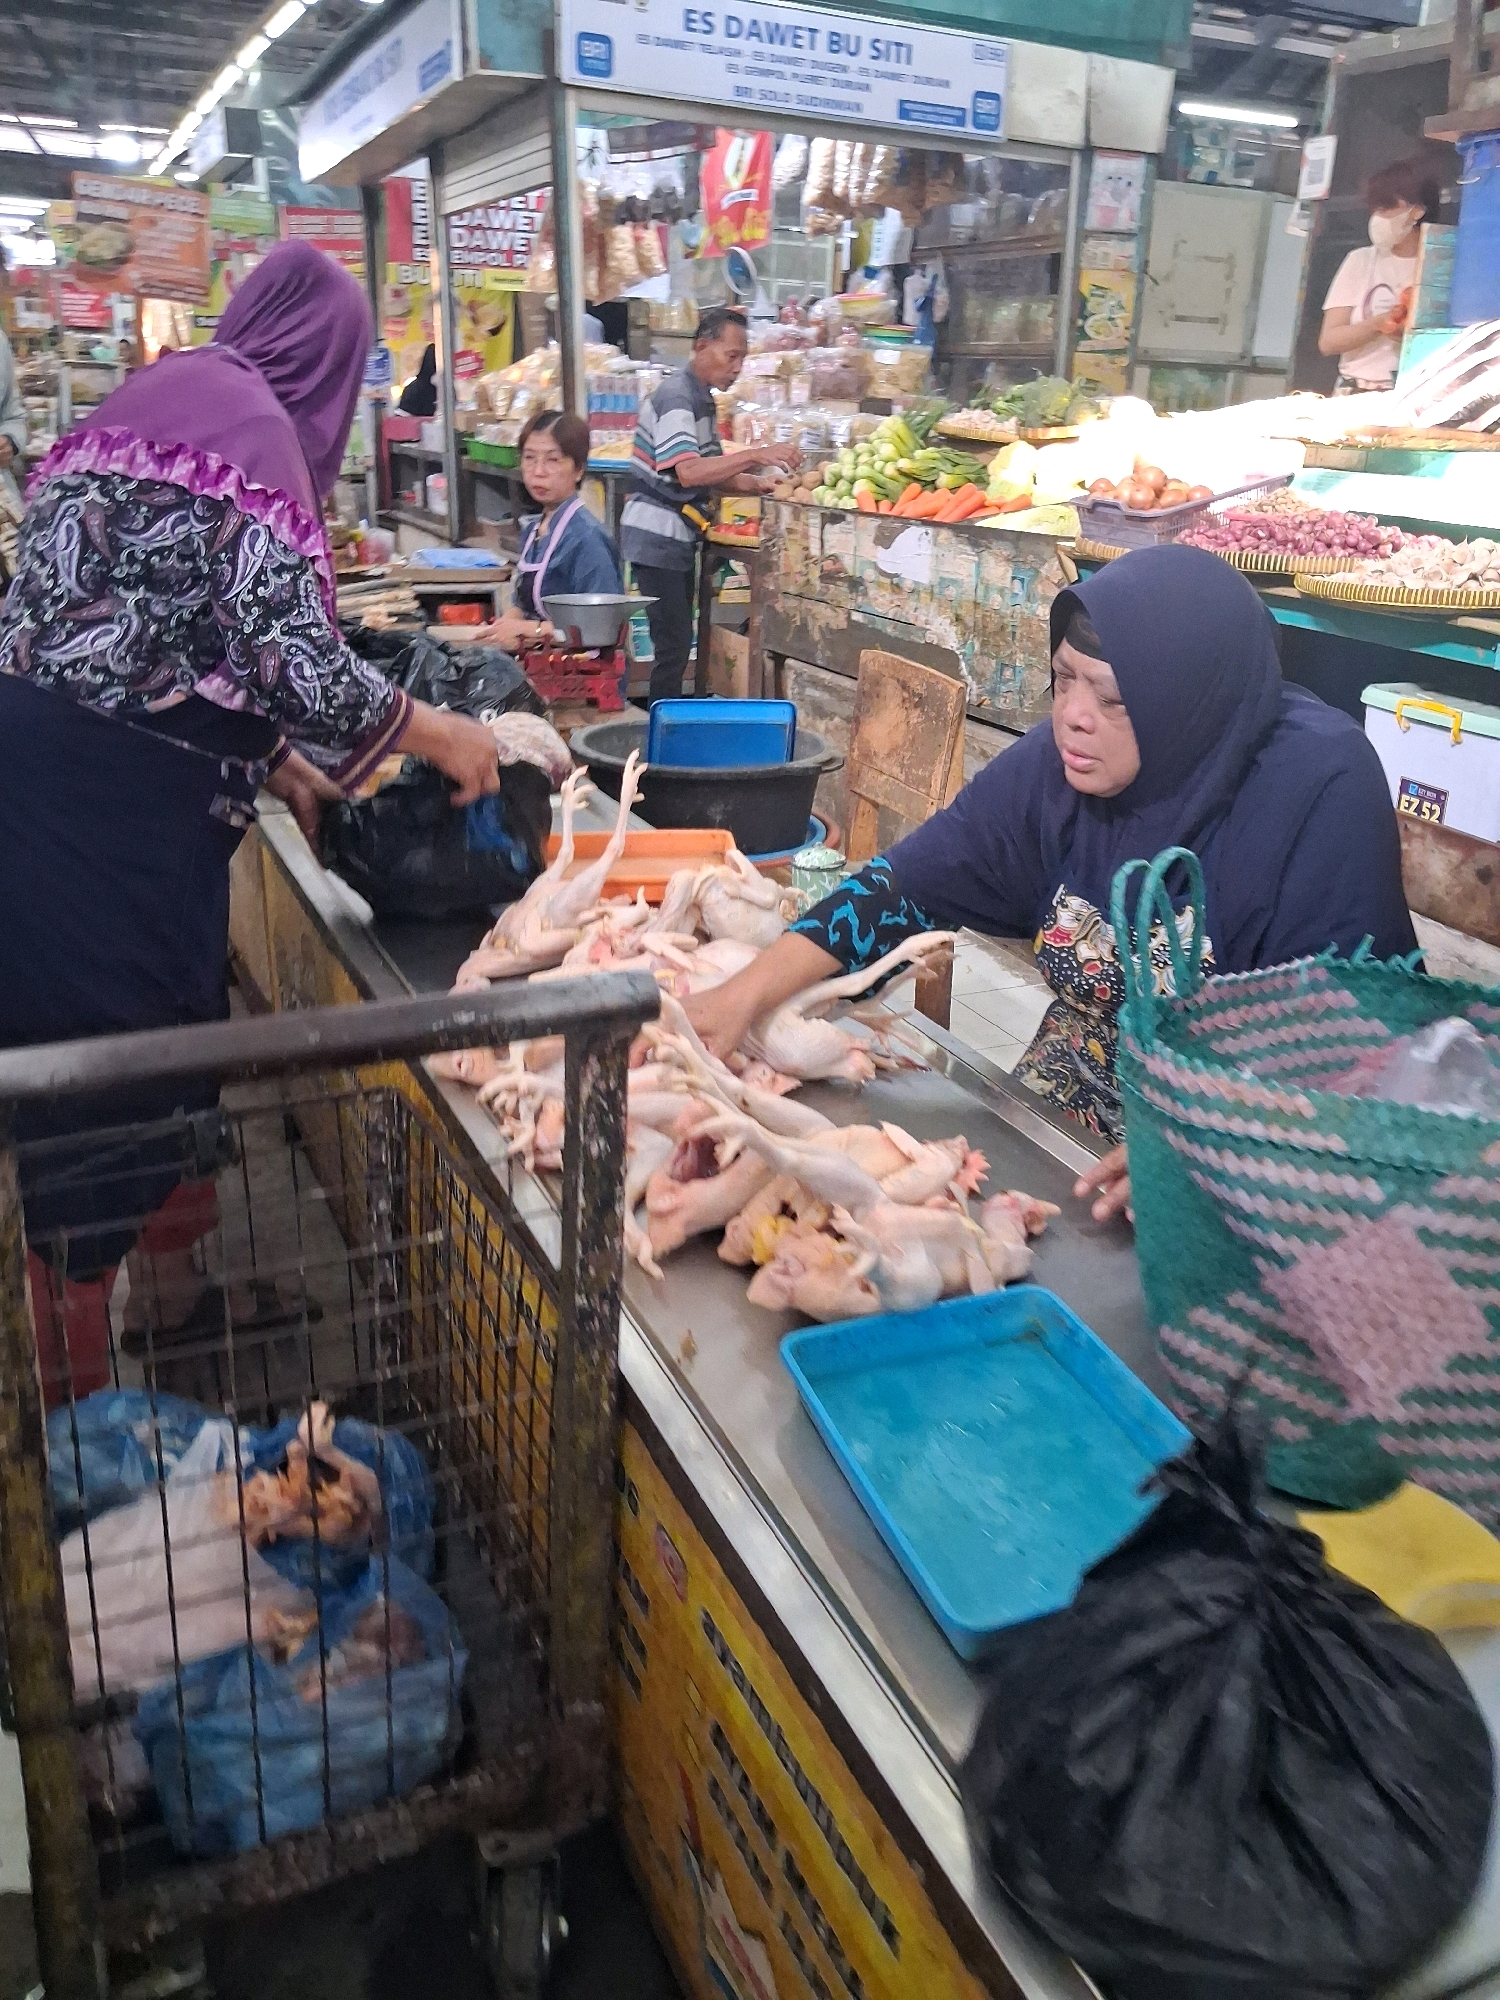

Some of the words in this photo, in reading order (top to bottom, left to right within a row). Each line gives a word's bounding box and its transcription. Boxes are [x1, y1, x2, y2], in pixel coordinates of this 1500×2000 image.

[684, 8, 715, 36] ES
[725, 14, 820, 51] DAWET
[827, 30, 862, 57] BU
[870, 37, 914, 66] SITI
[450, 250, 513, 267] EMPOL
[1400, 794, 1420, 816] EZ
[1420, 801, 1441, 823] 52
